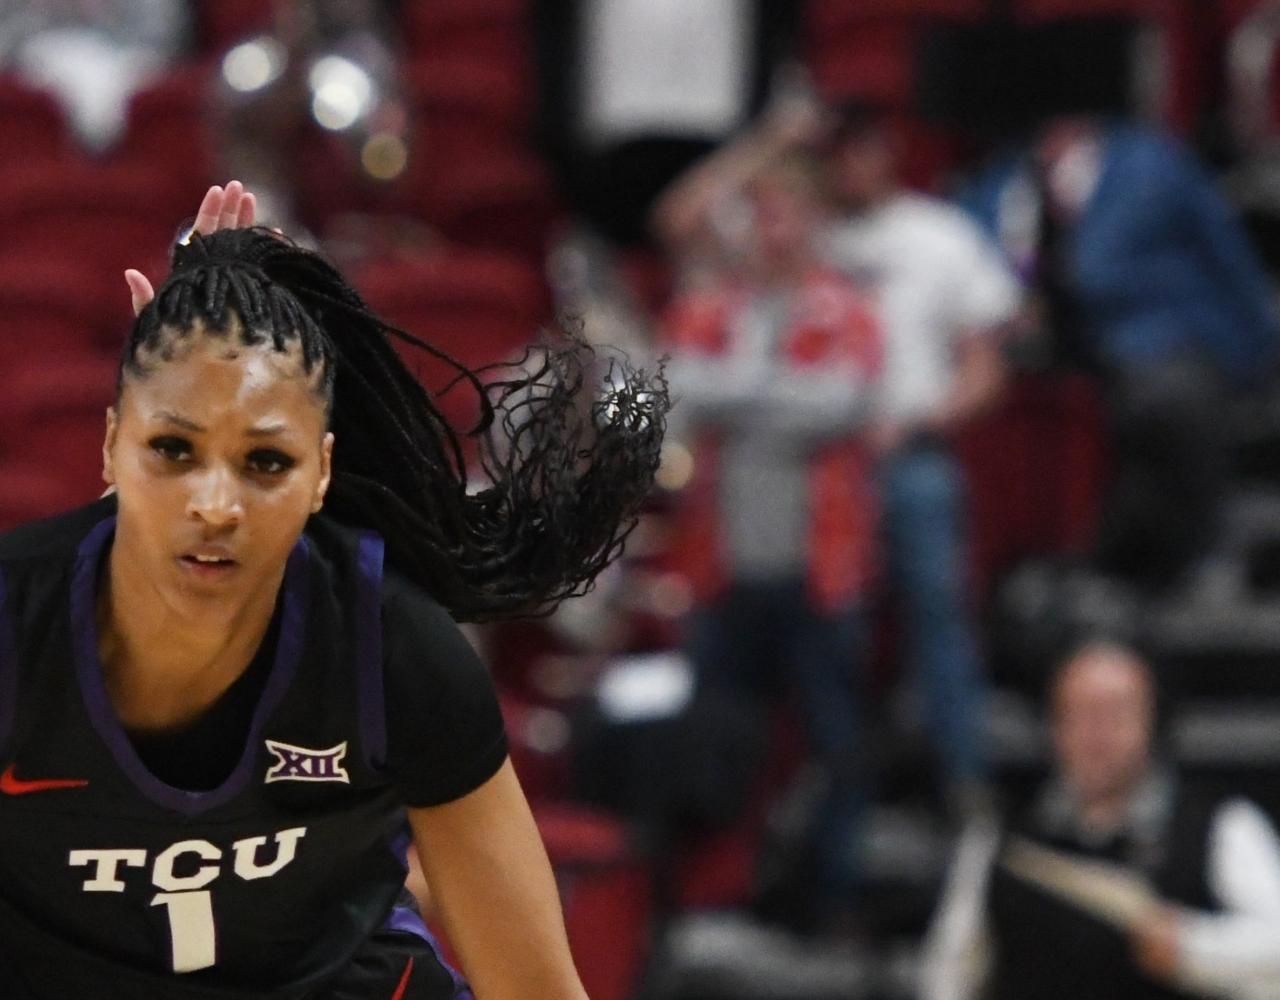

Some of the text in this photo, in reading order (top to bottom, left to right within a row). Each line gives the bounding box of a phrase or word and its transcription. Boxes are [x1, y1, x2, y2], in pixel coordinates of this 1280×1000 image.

[267, 742, 347, 781] XII
[68, 826, 308, 893] TCU
[150, 890, 216, 974] 1
